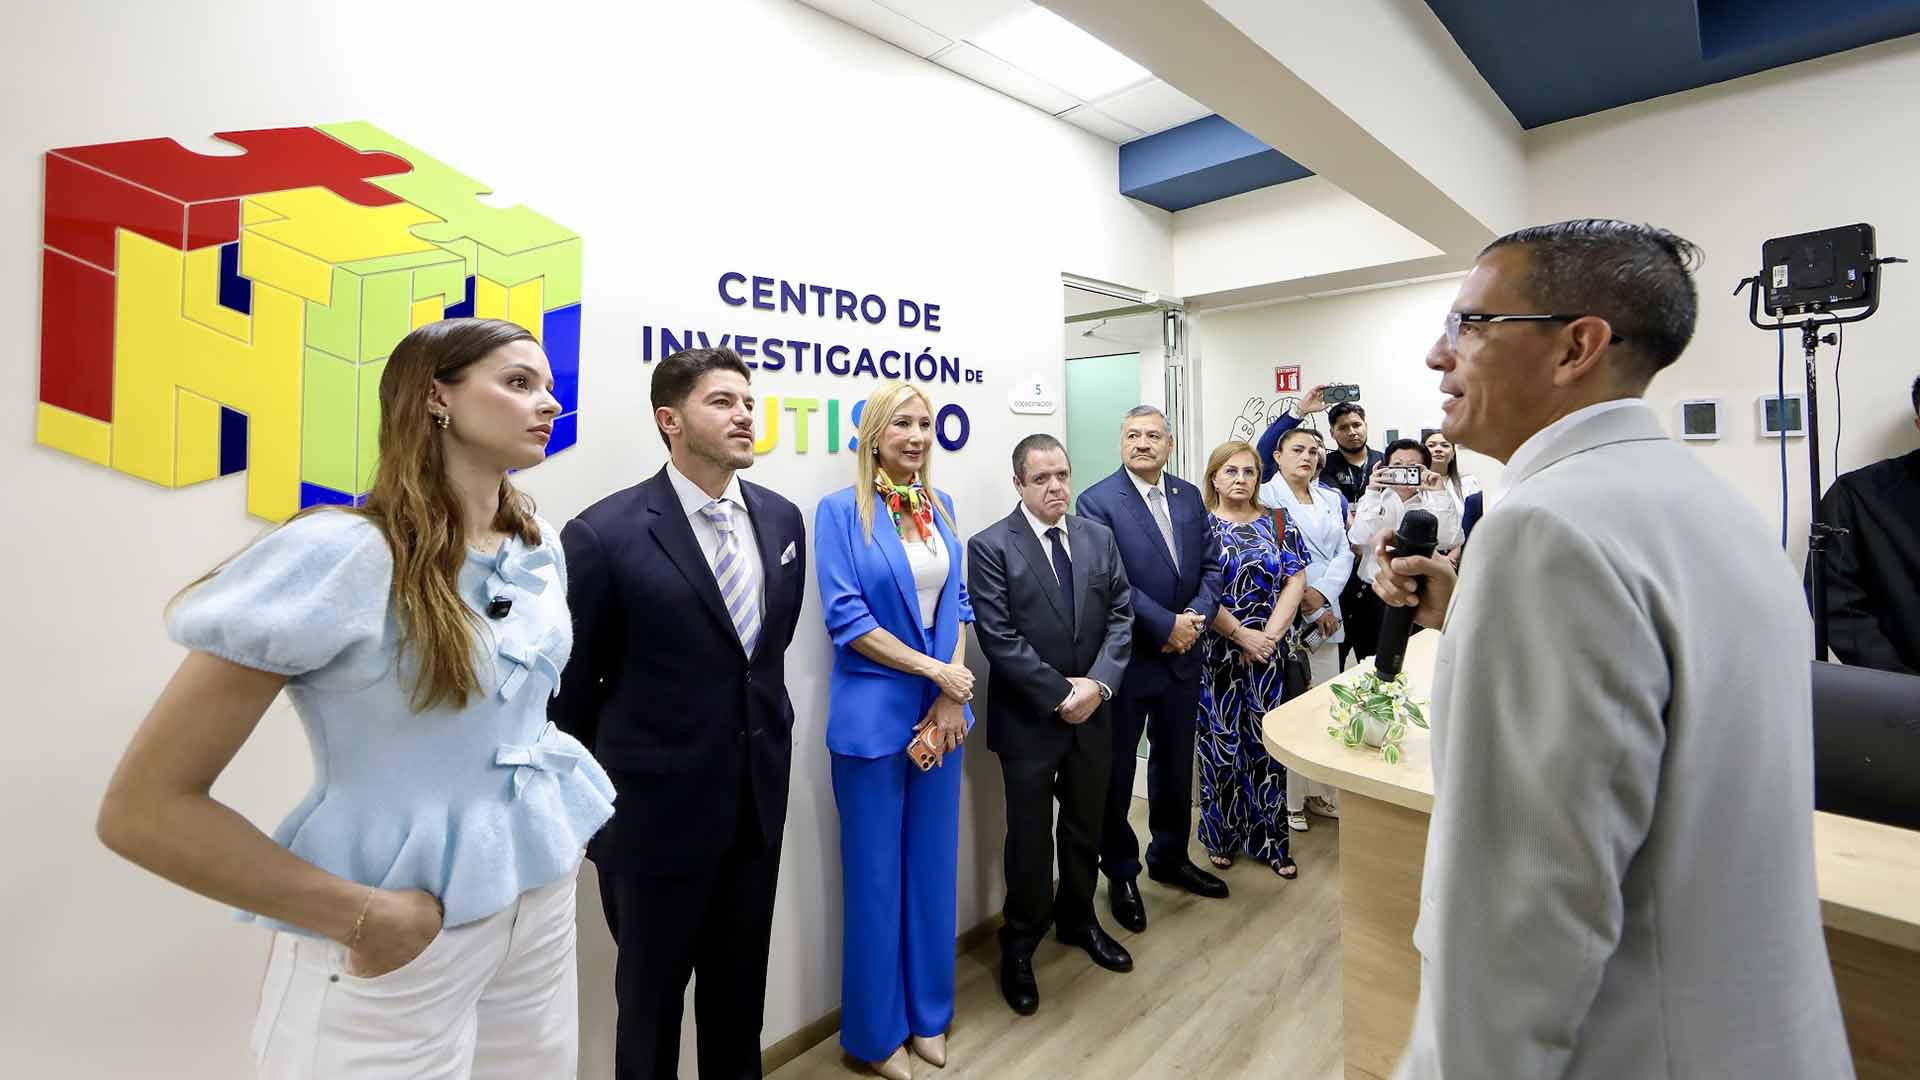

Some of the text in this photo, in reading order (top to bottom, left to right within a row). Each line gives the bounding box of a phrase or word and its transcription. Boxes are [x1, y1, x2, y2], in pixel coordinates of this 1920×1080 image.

[718, 271, 941, 332] CENTRO DE
[965, 369, 984, 383] DE
[1035, 383, 1042, 396] 5
